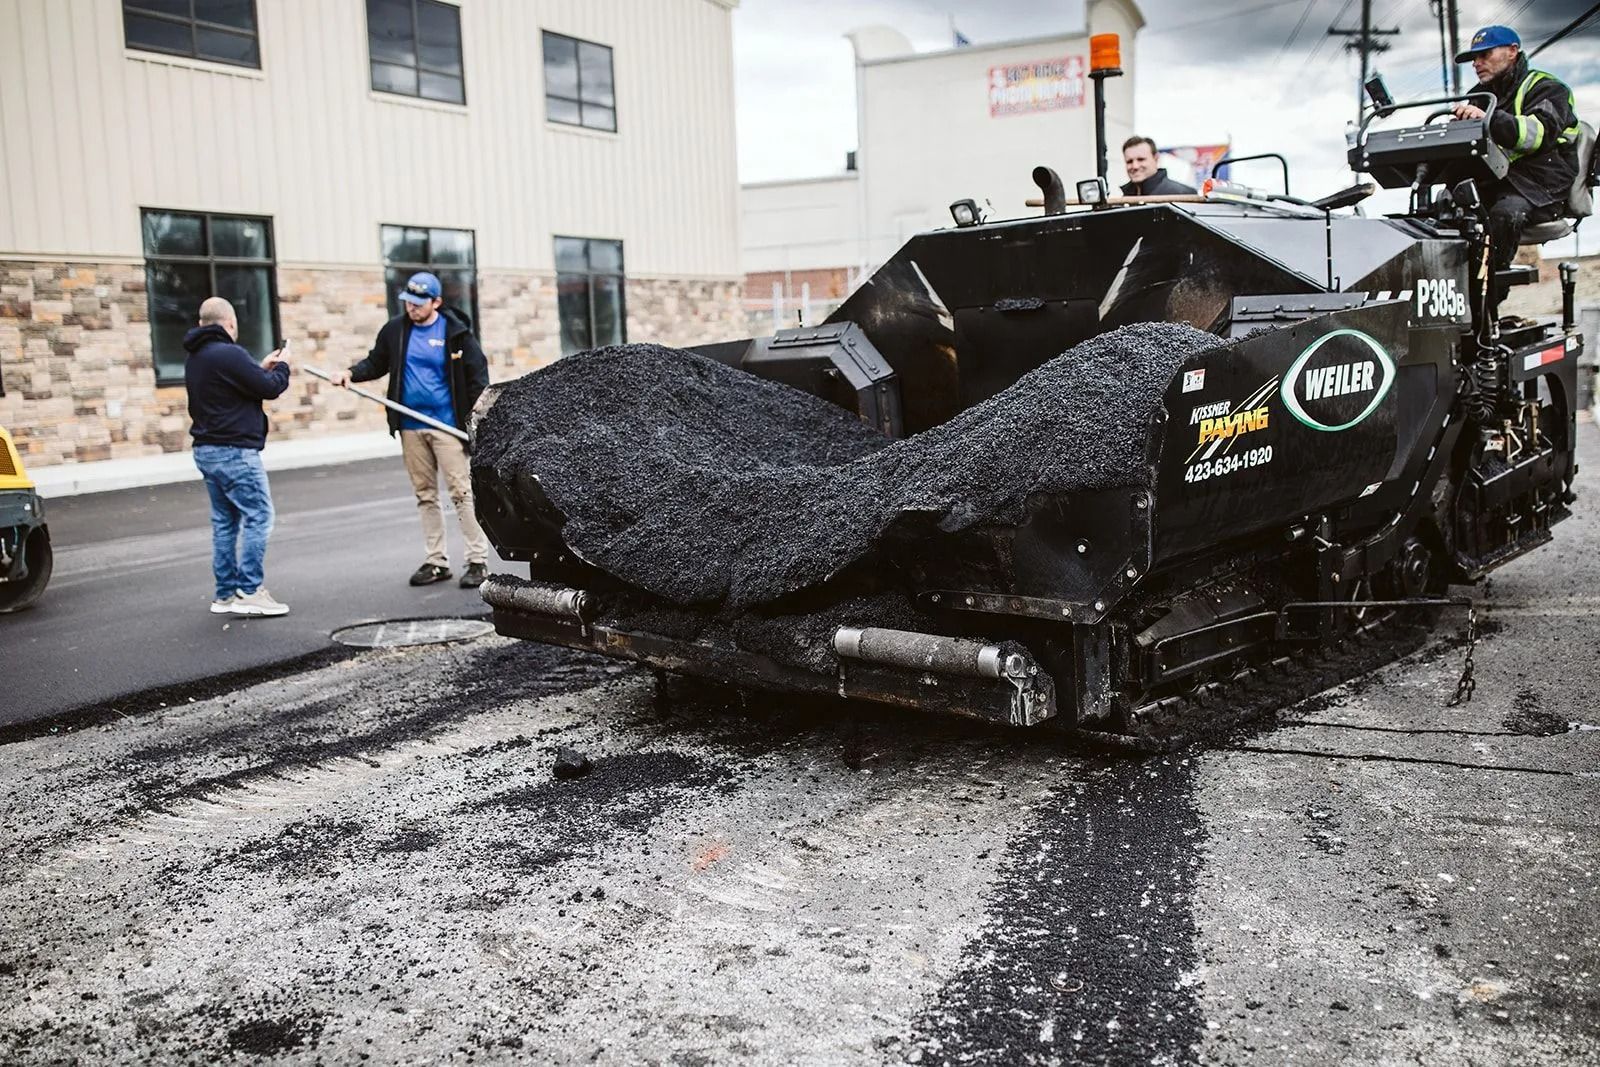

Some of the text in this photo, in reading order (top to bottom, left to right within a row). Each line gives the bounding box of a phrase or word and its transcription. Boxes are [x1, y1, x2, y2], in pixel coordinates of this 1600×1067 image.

[1417, 278, 1466, 318] P385B
[1305, 360, 1375, 401] WEILER
[1189, 400, 1231, 426] KISSNER
[1198, 406, 1269, 445] PAVING
[1184, 445, 1273, 483] 423-634-1920
